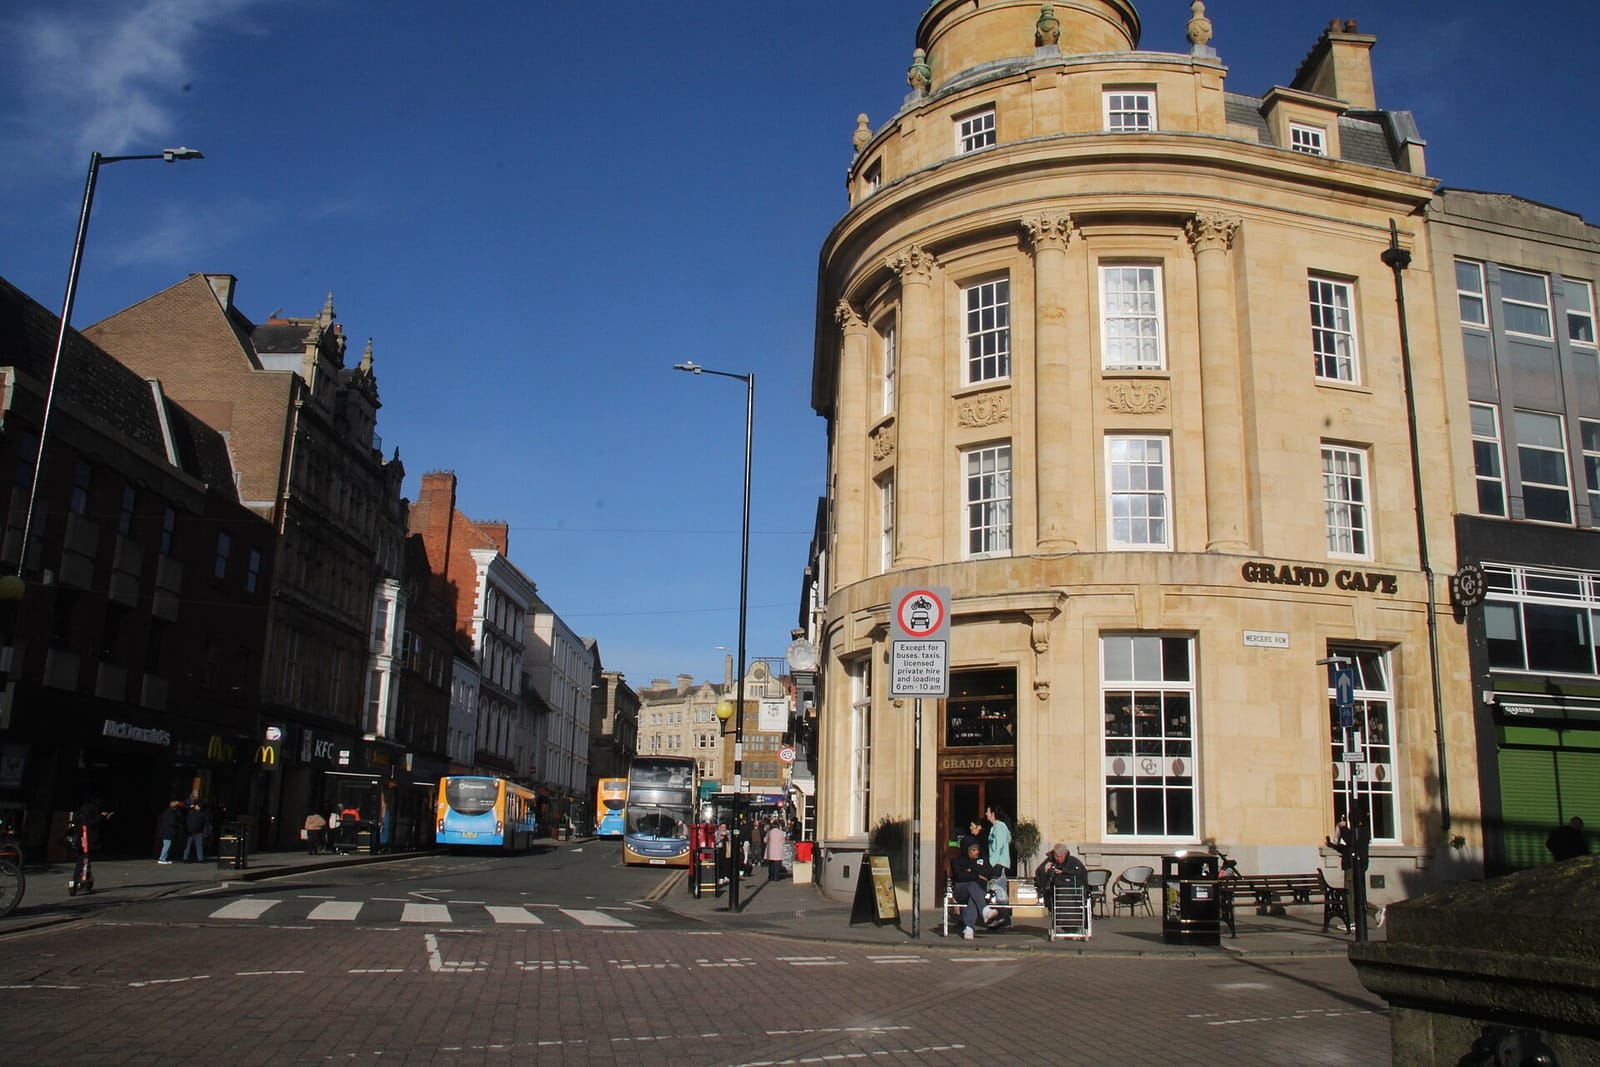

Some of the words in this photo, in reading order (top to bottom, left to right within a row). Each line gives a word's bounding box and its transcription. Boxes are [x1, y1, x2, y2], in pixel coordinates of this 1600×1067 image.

[1241, 561, 1329, 588] GRAND
[1335, 570, 1398, 594] CAFE
[1456, 564, 1478, 577] GRAND
[1246, 635, 1272, 643] MERCERS
[1275, 636, 1286, 644] ROW
[102, 719, 171, 747] McDonald's
[314, 739, 334, 760] KFC
[943, 759, 984, 769] GRAND
